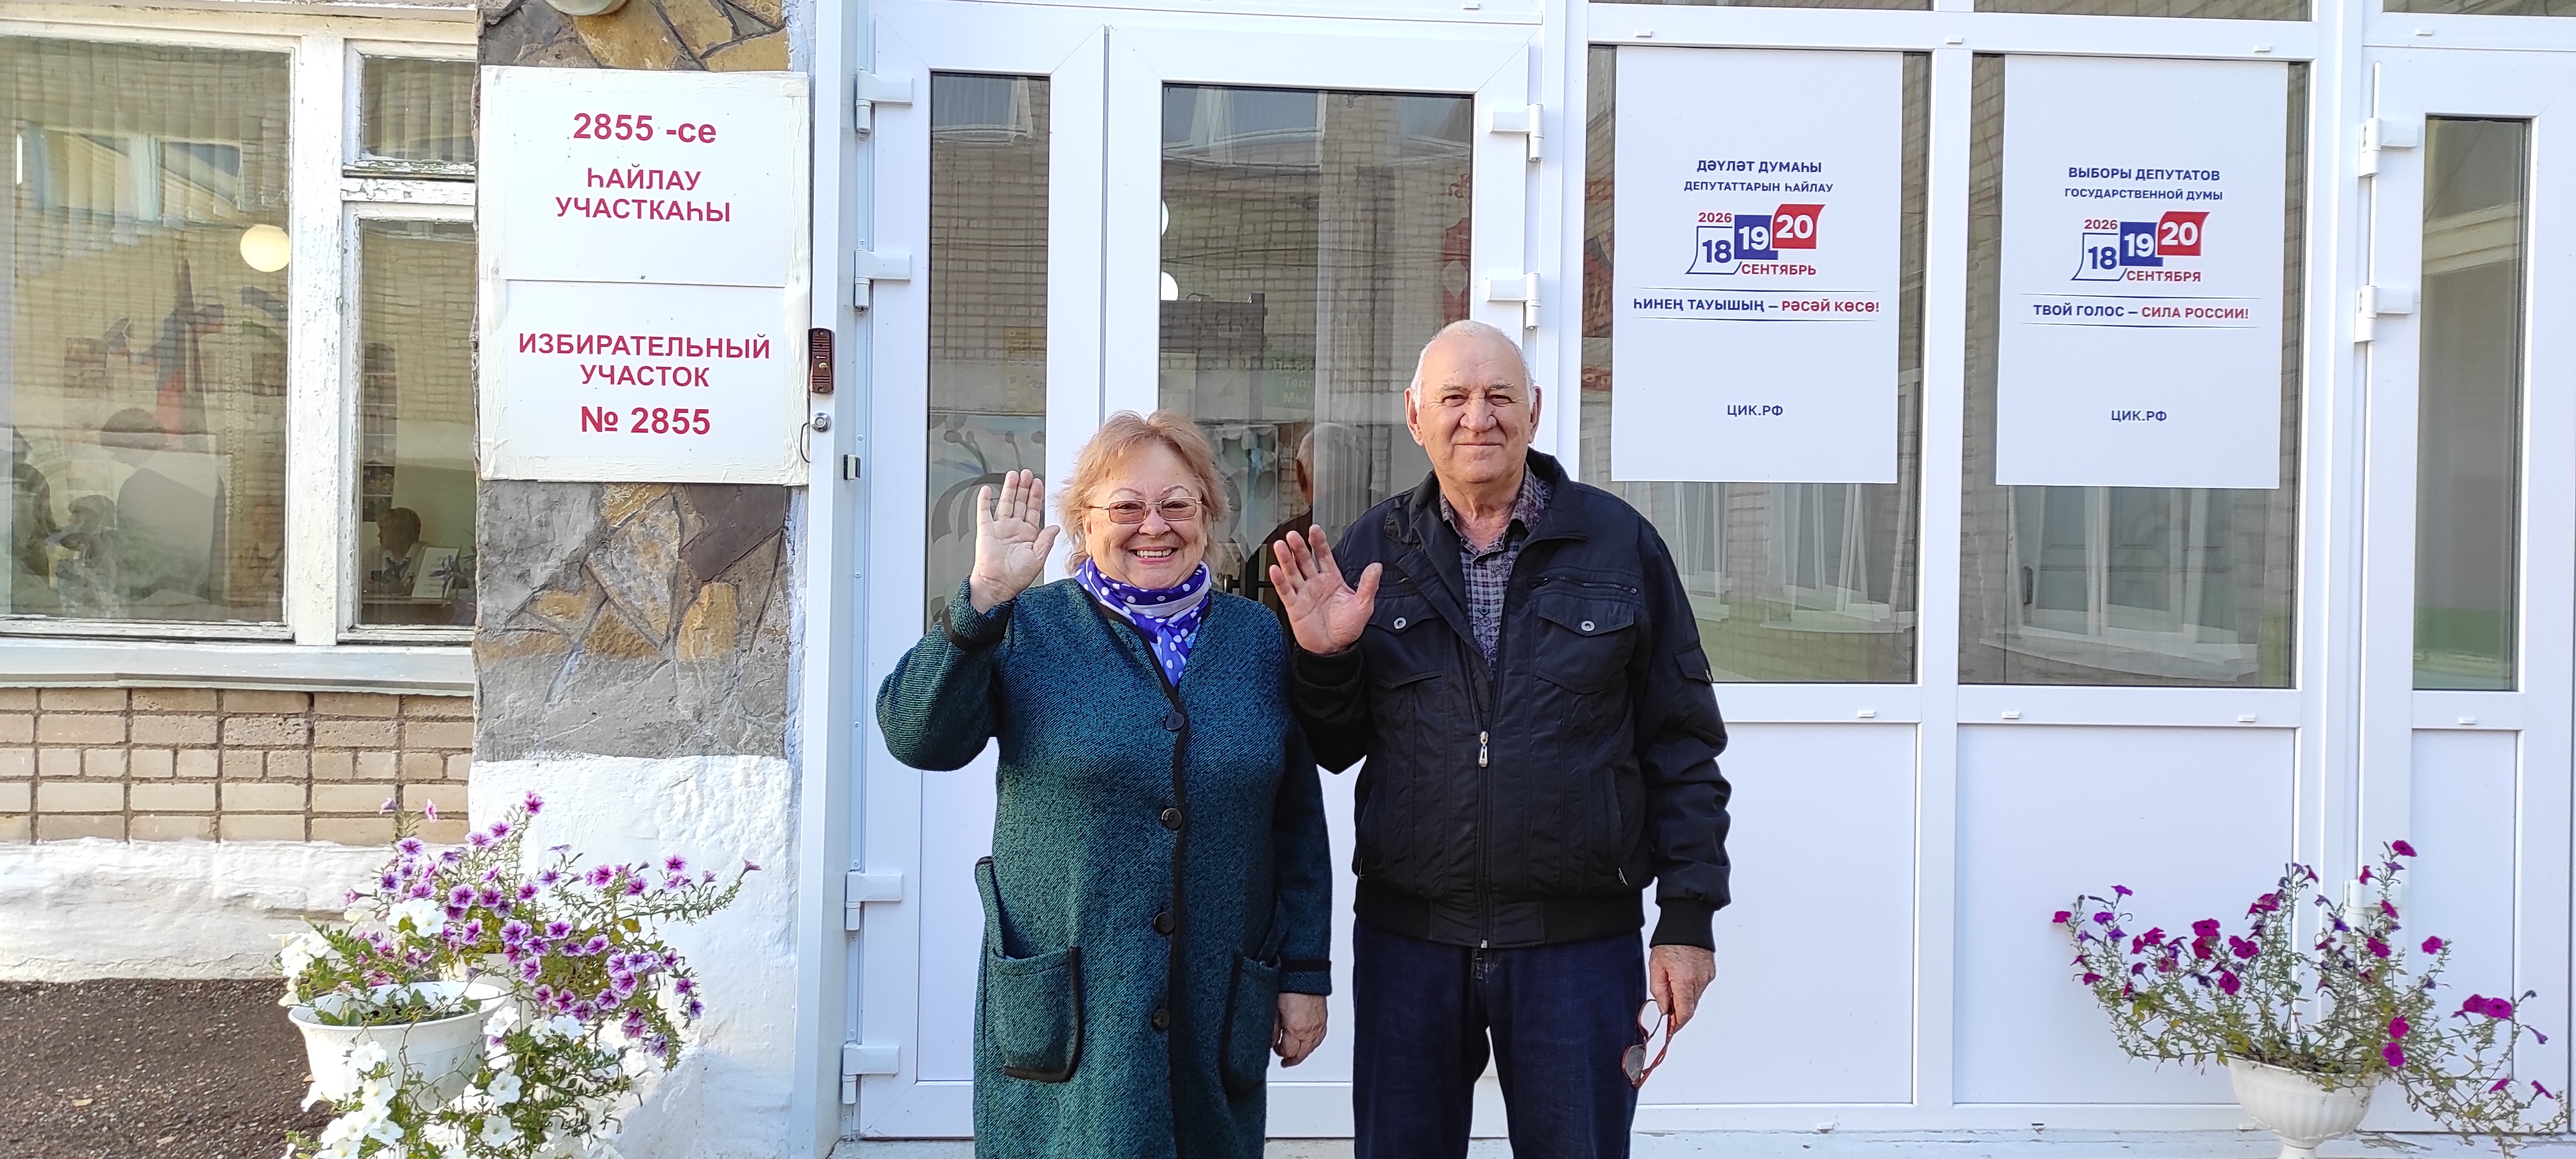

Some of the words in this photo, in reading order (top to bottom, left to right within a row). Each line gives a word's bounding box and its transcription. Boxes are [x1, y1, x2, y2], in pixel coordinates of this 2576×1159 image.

[574, 114, 653, 142] 2855
[667, 124, 717, 144] -се
[1698, 161, 1755, 173] ДӘҮЛӘТ
[1759, 162, 1822, 174] ДУМАҺЫ
[588, 164, 702, 191] ҺАЙЛАУ
[2070, 168, 2132, 179] ВЫБОРЫ
[2136, 170, 2220, 182] ДЕПУТАТОВ
[1685, 182, 1780, 192] ДЕПУТАТТАРЫН
[1785, 182, 1834, 193] ҺАЙЛАУ
[2066, 189, 2183, 200] ГОСУДАРСТВЕННОЙ
[2187, 192, 2223, 201] ДУМЫ
[556, 198, 730, 222] УЧАСТКАҺЫ
[1699, 213, 1732, 223] 2026
[2085, 220, 2118, 230] 2026
[1703, 240, 1732, 264] 18
[1739, 226, 1769, 250] 19
[1777, 214, 1814, 239] 20
[2089, 247, 2117, 270] 18
[2124, 234, 2154, 257] 19
[2161, 221, 2198, 246] 20
[1742, 264, 1817, 275] СЕНТЯБРЬ
[2127, 271, 2201, 283] СЕНТЯБРЯ
[1634, 299, 1684, 311] ҺИНЕҢ
[1688, 300, 1765, 313] ТАУЫШЫҢ
[1783, 299, 1830, 312] РӘСӘЙ
[1835, 302, 1879, 313] КӨСӨ!
[2034, 303, 2072, 316] ТВОЙ
[2077, 306, 2125, 317] ГОЛОС
[2142, 308, 2181, 318] СИЛА
[2186, 309, 2248, 319] РОССИИ!
[520, 334, 769, 359] ИЗБИРАТЕЛЬНЫЙ
[581, 365, 710, 387] УЧАСТОК
[1728, 406, 1783, 417] ЦИК.РФ
[2112, 411, 2167, 422] ЦИК.РФ
[582, 407, 618, 432] №
[632, 408, 711, 435] 2855
